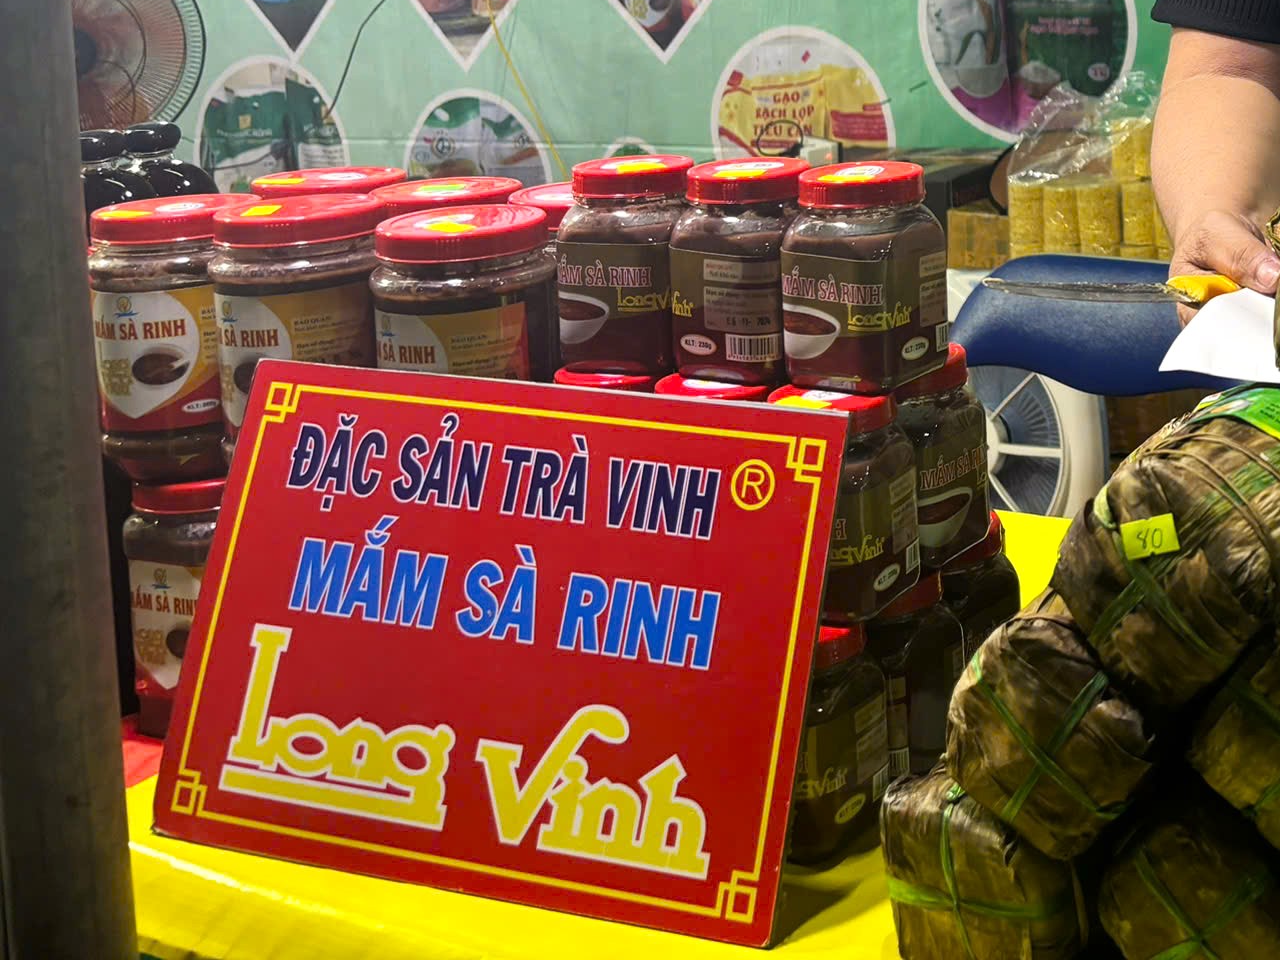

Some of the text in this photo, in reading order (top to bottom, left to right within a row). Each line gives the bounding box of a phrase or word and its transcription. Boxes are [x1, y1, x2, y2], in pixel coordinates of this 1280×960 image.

[558, 253, 652, 288] ẮM SÀ RINH
[817, 274, 839, 303] SÀ
[840, 282, 884, 306] RINH
[119, 319, 138, 341] SÀ
[143, 319, 187, 340] RINH
[224, 324, 279, 348] SÀ RINH
[382, 339, 436, 364] SÀ RINH
[287, 414, 388, 512] ĐẶC
[391, 412, 494, 511] SẢN
[500, 434, 591, 524] TRÀ
[606, 456, 722, 539] VINH
[920, 454, 956, 491] MẮM
[156, 591, 171, 614] SÀ
[287, 514, 721, 670] MẮM SÀ RINH
[218, 622, 456, 832] Long
